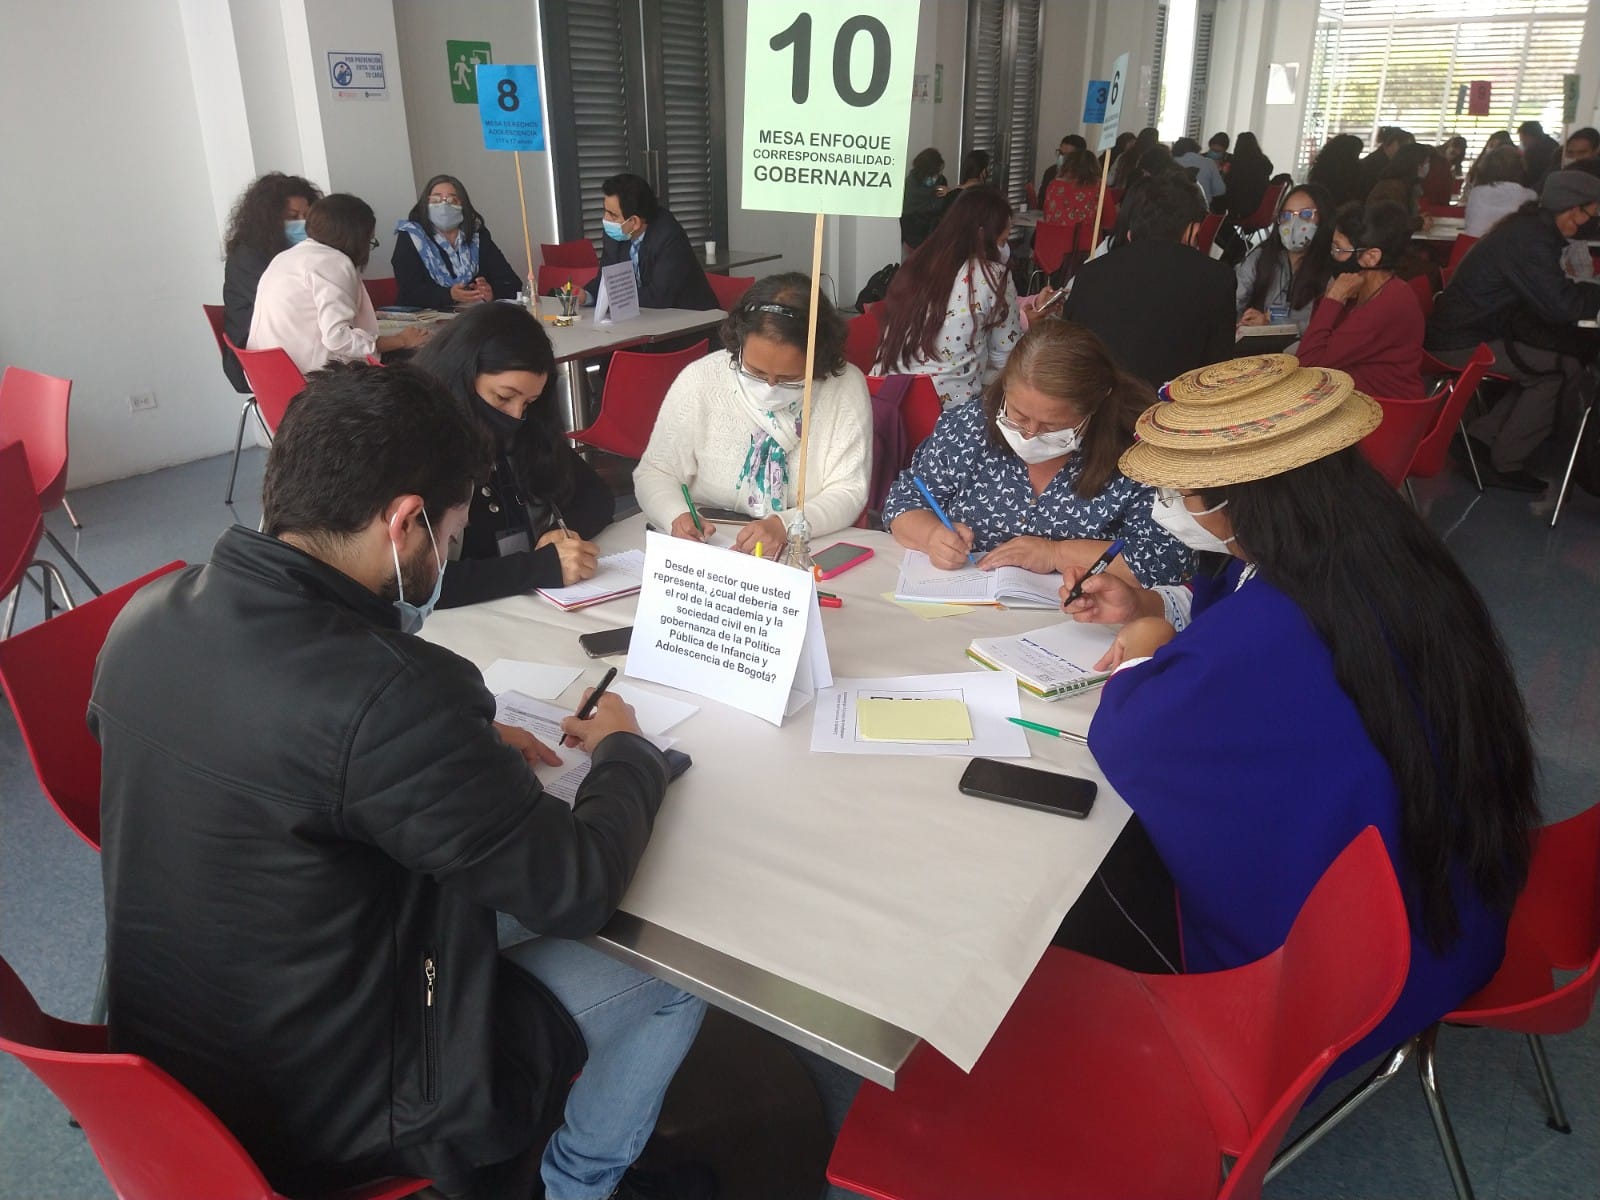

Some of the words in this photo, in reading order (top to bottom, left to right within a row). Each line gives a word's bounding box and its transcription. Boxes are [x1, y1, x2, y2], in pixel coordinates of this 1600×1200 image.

[769, 12, 892, 108] 10
[497, 79, 520, 112] 8
[1096, 87, 1107, 105] 3
[1111, 70, 1121, 106] 6
[759, 129, 805, 146] MESA
[810, 132, 891, 150] ENFOQUE
[753, 149, 895, 166] CORRESPONSABILIDAD:
[754, 165, 892, 188] GOBERNANZA
[653, 571, 708, 594] representa,
[782, 606, 800, 617] ser
[665, 558, 695, 575] Desde
[696, 568, 705, 578] el
[707, 572, 738, 586] sector
[740, 581, 760, 592] que
[762, 586, 791, 600] usted
[665, 588, 674, 598] el
[675, 592, 689, 602] rol
[690, 594, 703, 606] de
[704, 597, 713, 609] la
[715, 602, 764, 622] academia
[765, 616, 772, 626] y
[774, 616, 783, 627] la
[676, 605, 720, 624] sociedad
[721, 617, 742, 631] civil
[743, 624, 756, 634] en
[758, 626, 768, 637] la
[660, 614, 716, 637] gobernanza
[718, 630, 731, 641] de
[733, 633, 742, 645] la
[655, 639, 721, 666] Adolescencia
[722, 659, 735, 671] de
[737, 662, 777, 684] Bogotá?
[669, 628, 705, 647] Pública
[706, 640, 719, 652] de
[721, 644, 760, 664] Infancia
[761, 657, 769, 668] y
